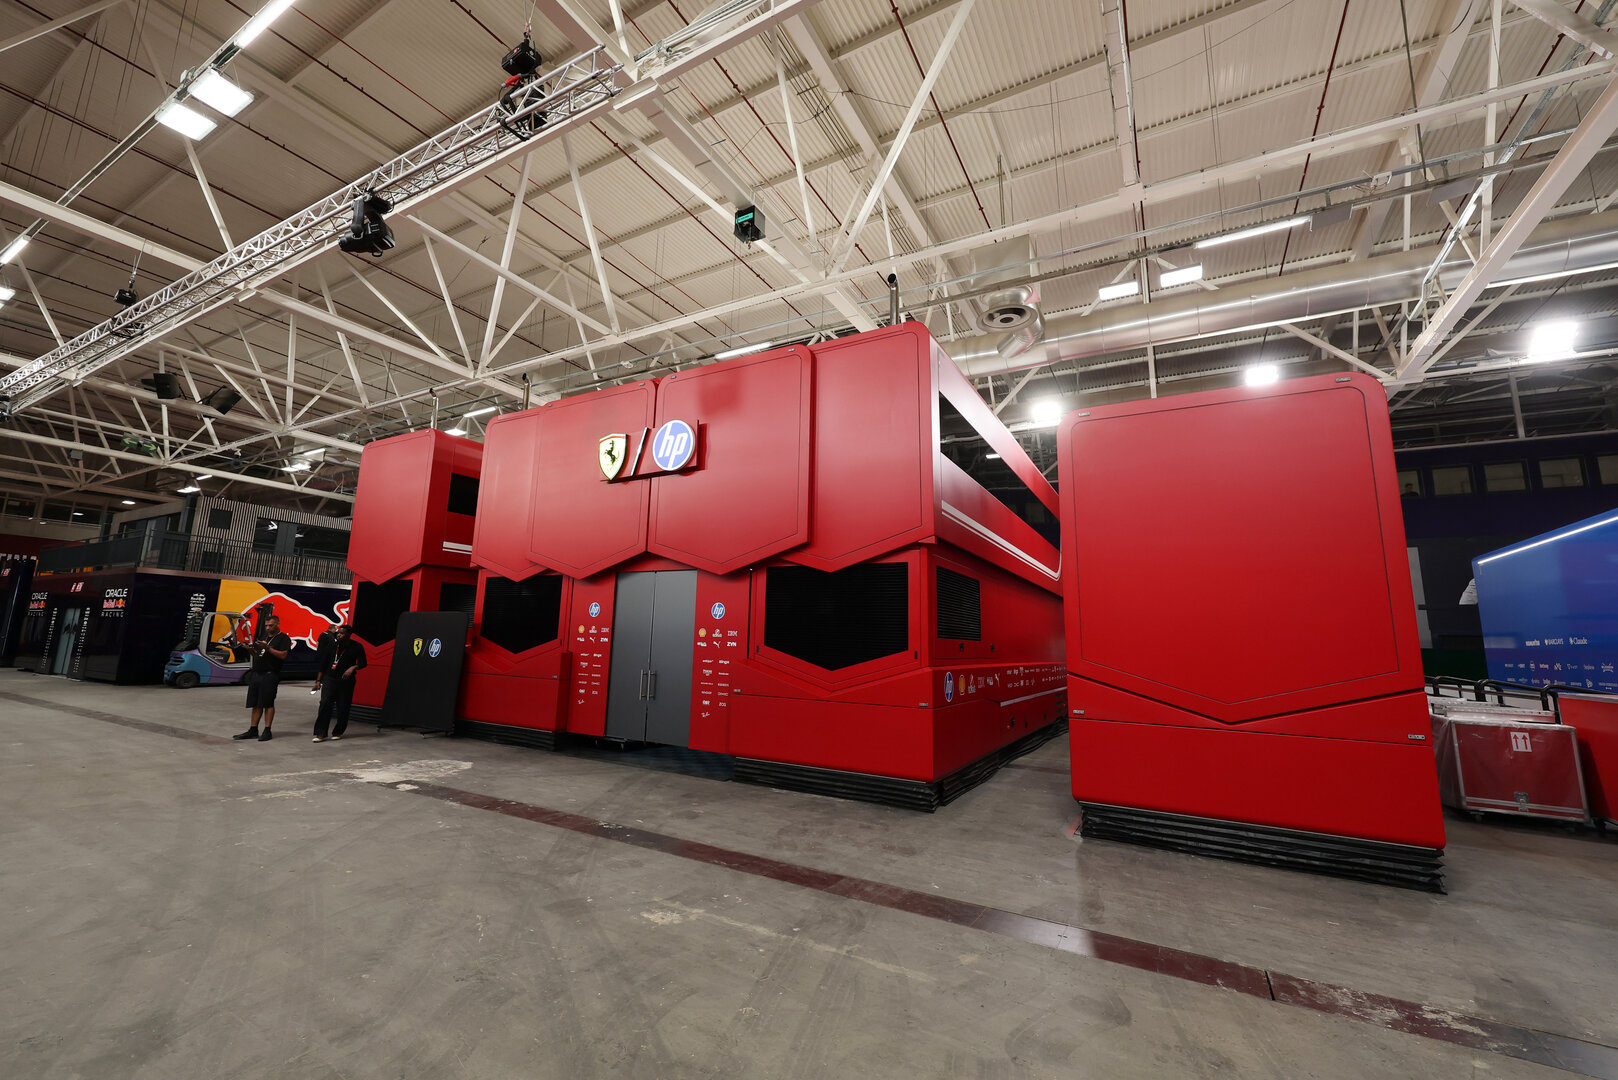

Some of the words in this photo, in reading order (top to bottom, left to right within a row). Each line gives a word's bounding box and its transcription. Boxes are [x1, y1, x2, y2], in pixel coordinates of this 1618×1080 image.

[656, 421, 690, 469] hp
[31, 592, 48, 600] ORACLE
[105, 588, 128, 598] ORACLE
